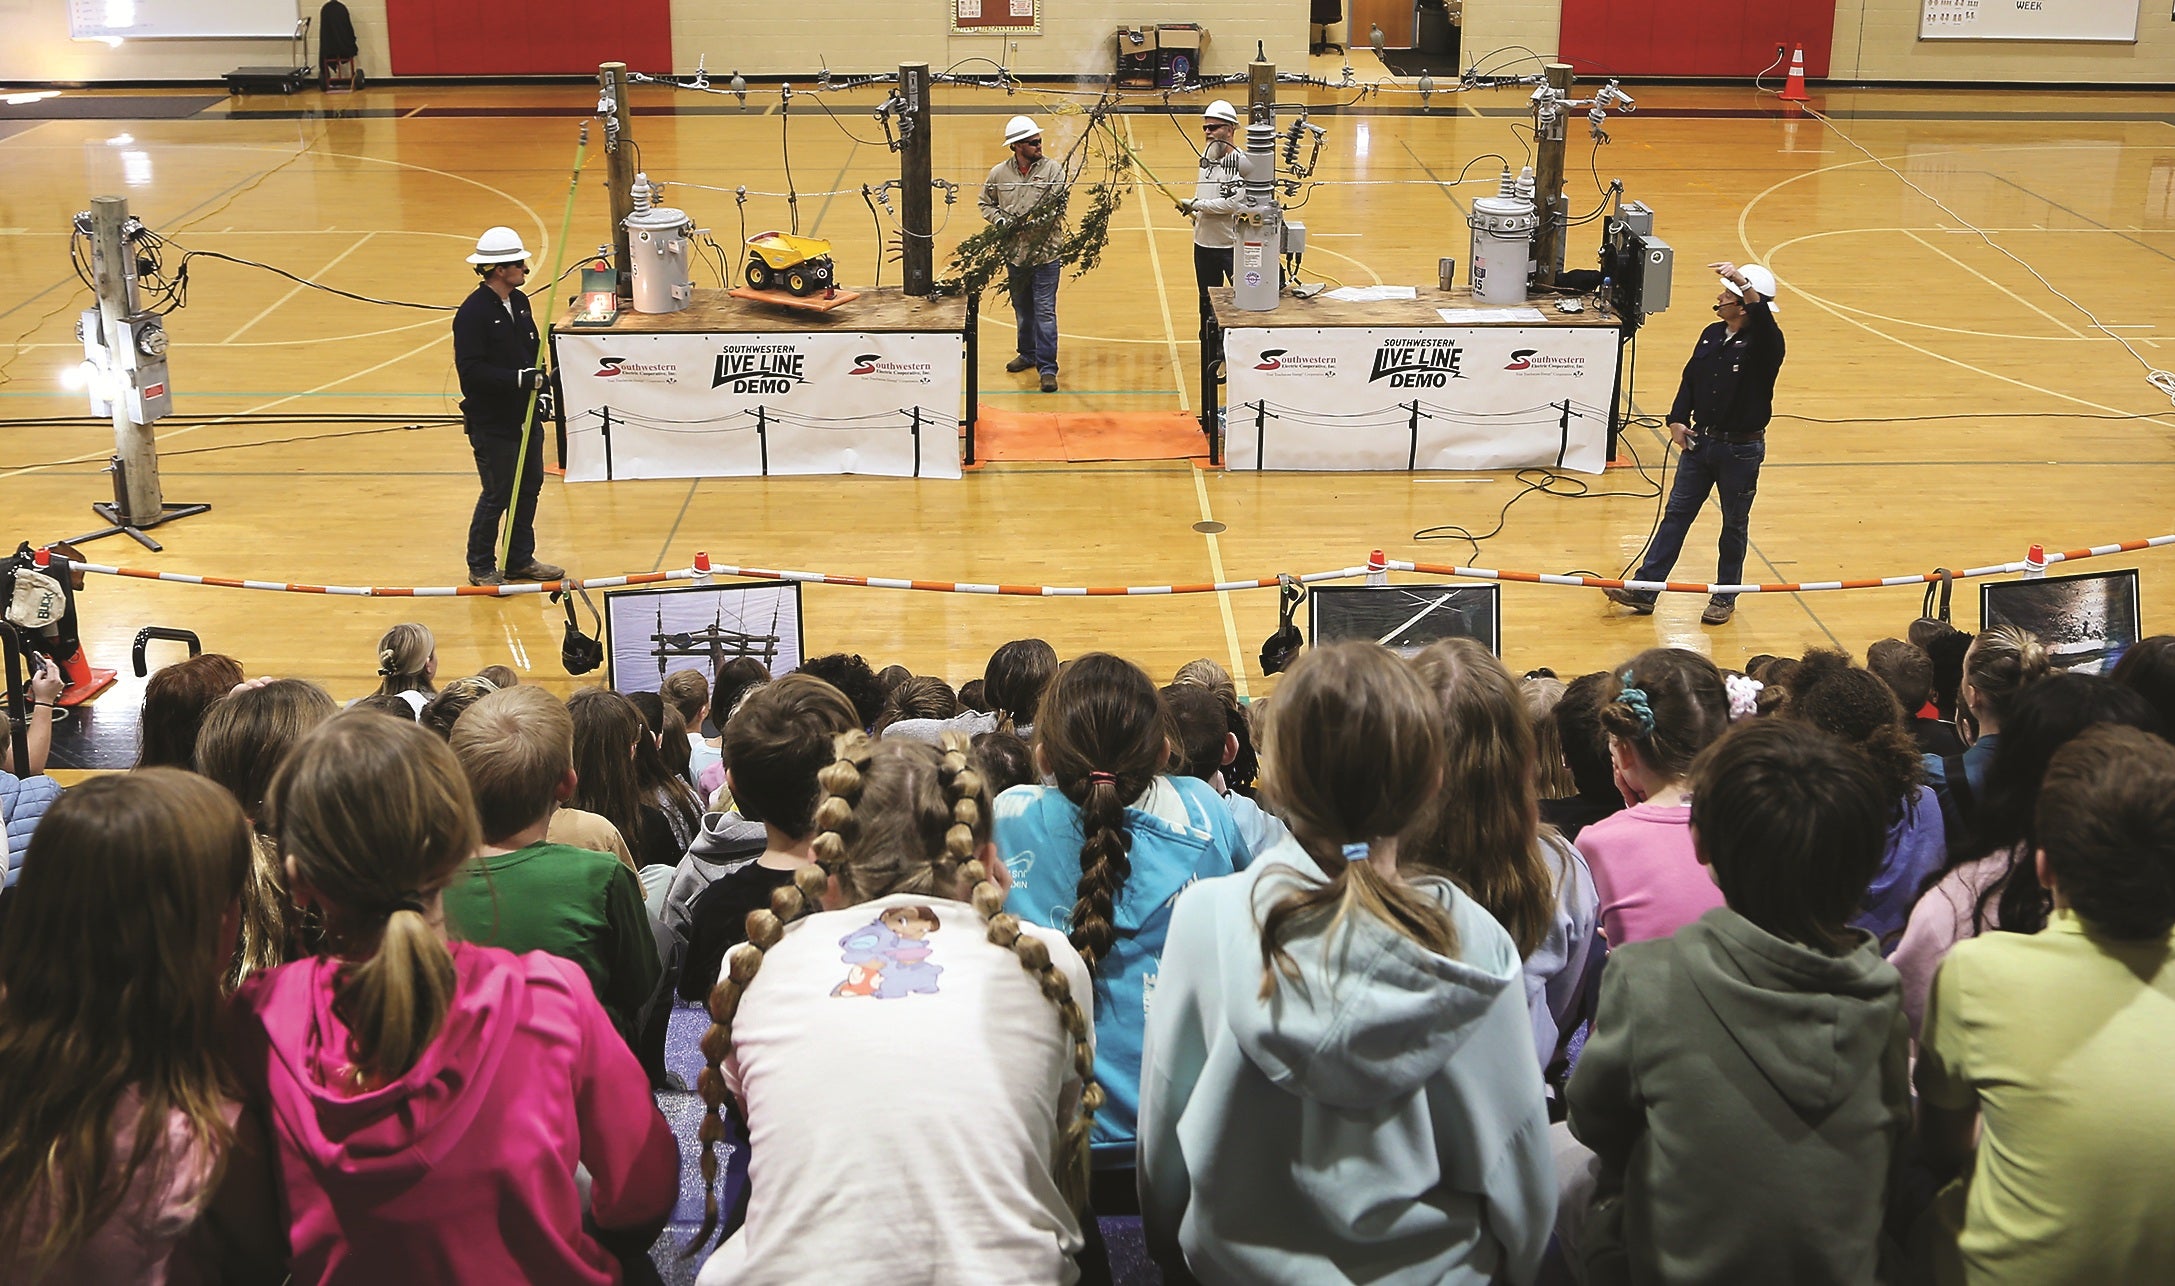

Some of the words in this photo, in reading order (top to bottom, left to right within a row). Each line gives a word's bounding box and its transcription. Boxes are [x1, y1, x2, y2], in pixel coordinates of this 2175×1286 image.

[2016, 0, 2042, 10] WEEK
[1474, 278, 1483, 290] 15
[723, 345, 795, 354] SOUTHWESTERN
[1384, 338, 1455, 347] SOUTHWESTERN
[760, 354, 804, 376] LINE
[848, 354, 931, 375] Southwestern
[1253, 349, 1336, 370] Southwestern
[1418, 348, 1463, 370] LINE
[1503, 349, 1585, 370] Southwestern
[593, 357, 676, 377] Southwestern
[733, 379, 791, 394] DEMO
[1389, 373, 1447, 388] DEMO
[1008, 869, 1027, 878] JUS
[1010, 880, 1028, 889] NIK
